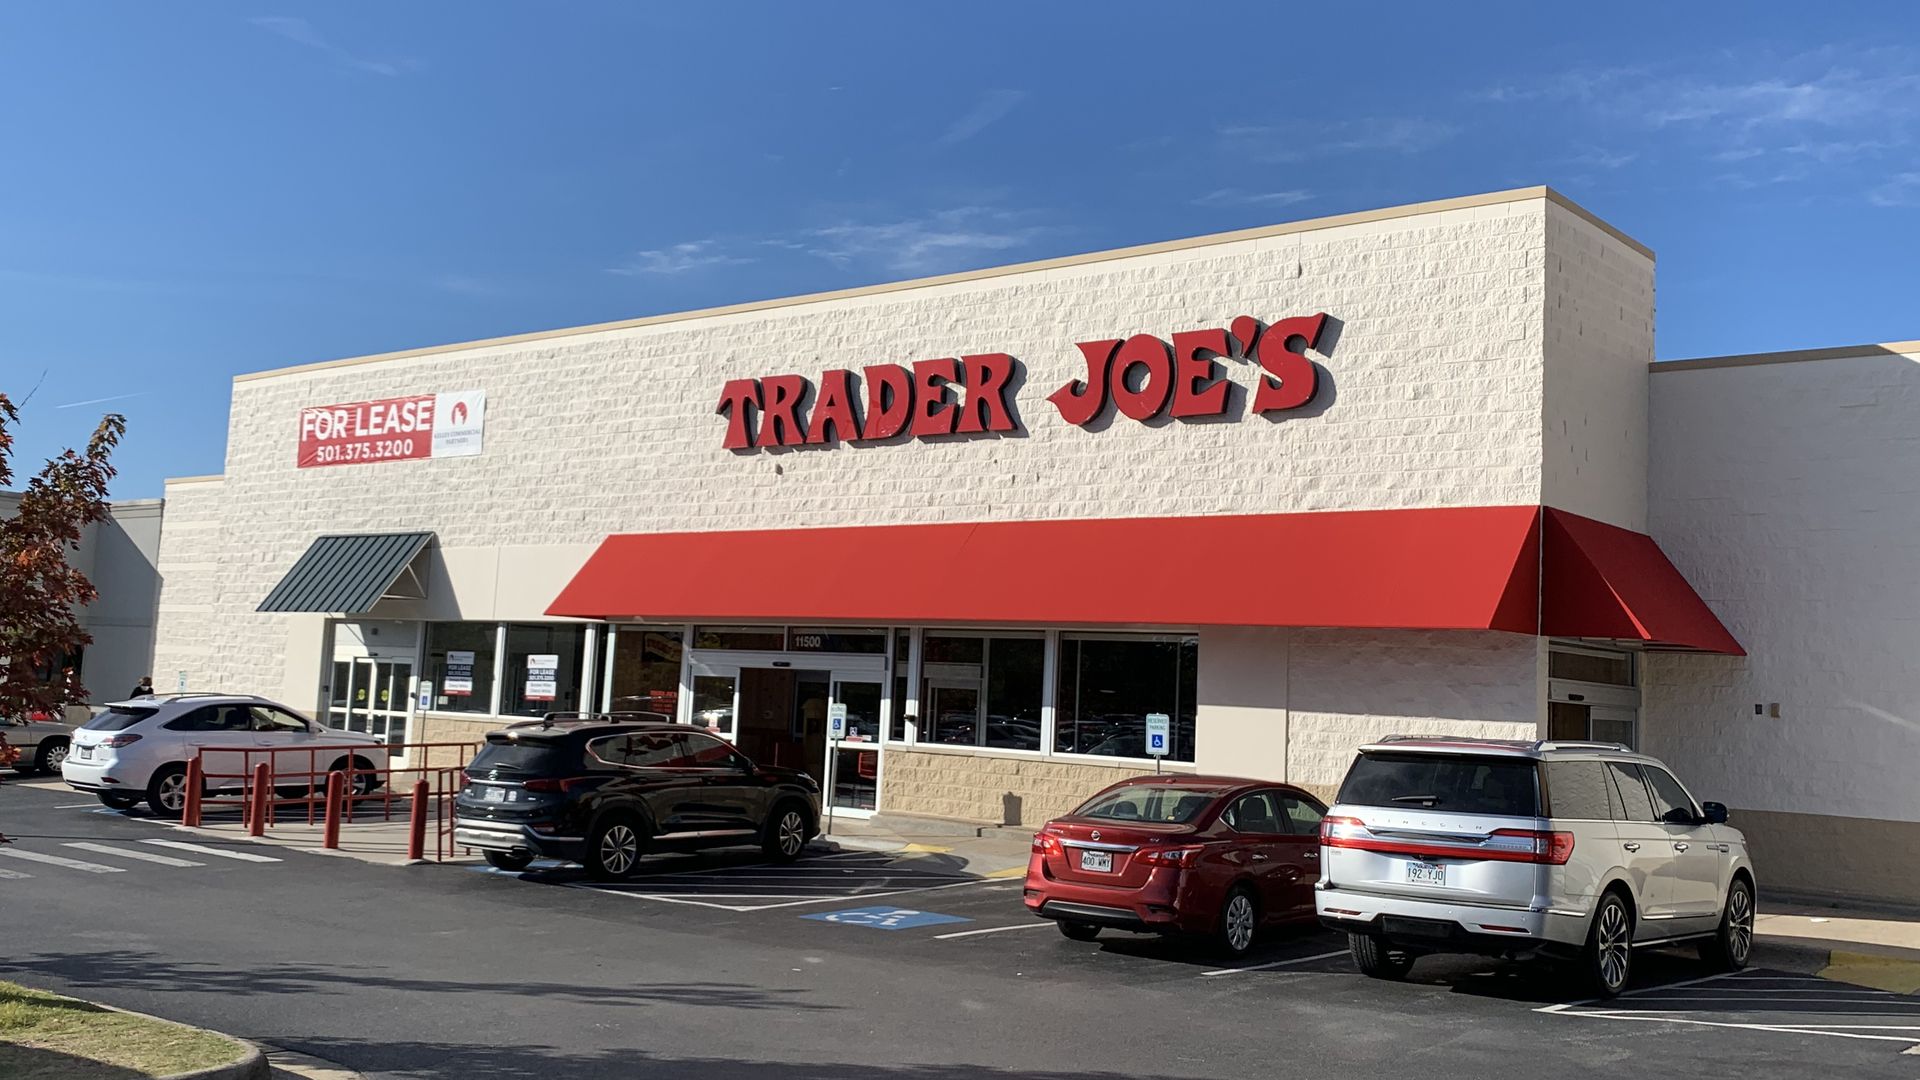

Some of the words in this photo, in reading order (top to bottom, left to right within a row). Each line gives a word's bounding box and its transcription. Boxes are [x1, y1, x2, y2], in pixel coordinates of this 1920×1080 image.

[716, 352, 1018, 450] TRADER
[1046, 312, 1329, 426] JOE'S
[302, 410, 347, 441] FOR
[355, 401, 433, 436] LEASE
[316, 439, 413, 462] 501.375.3200
[795, 636, 821, 648] 11500
[1083, 856, 1095, 866] 400
[1407, 868, 1422, 879] 192
